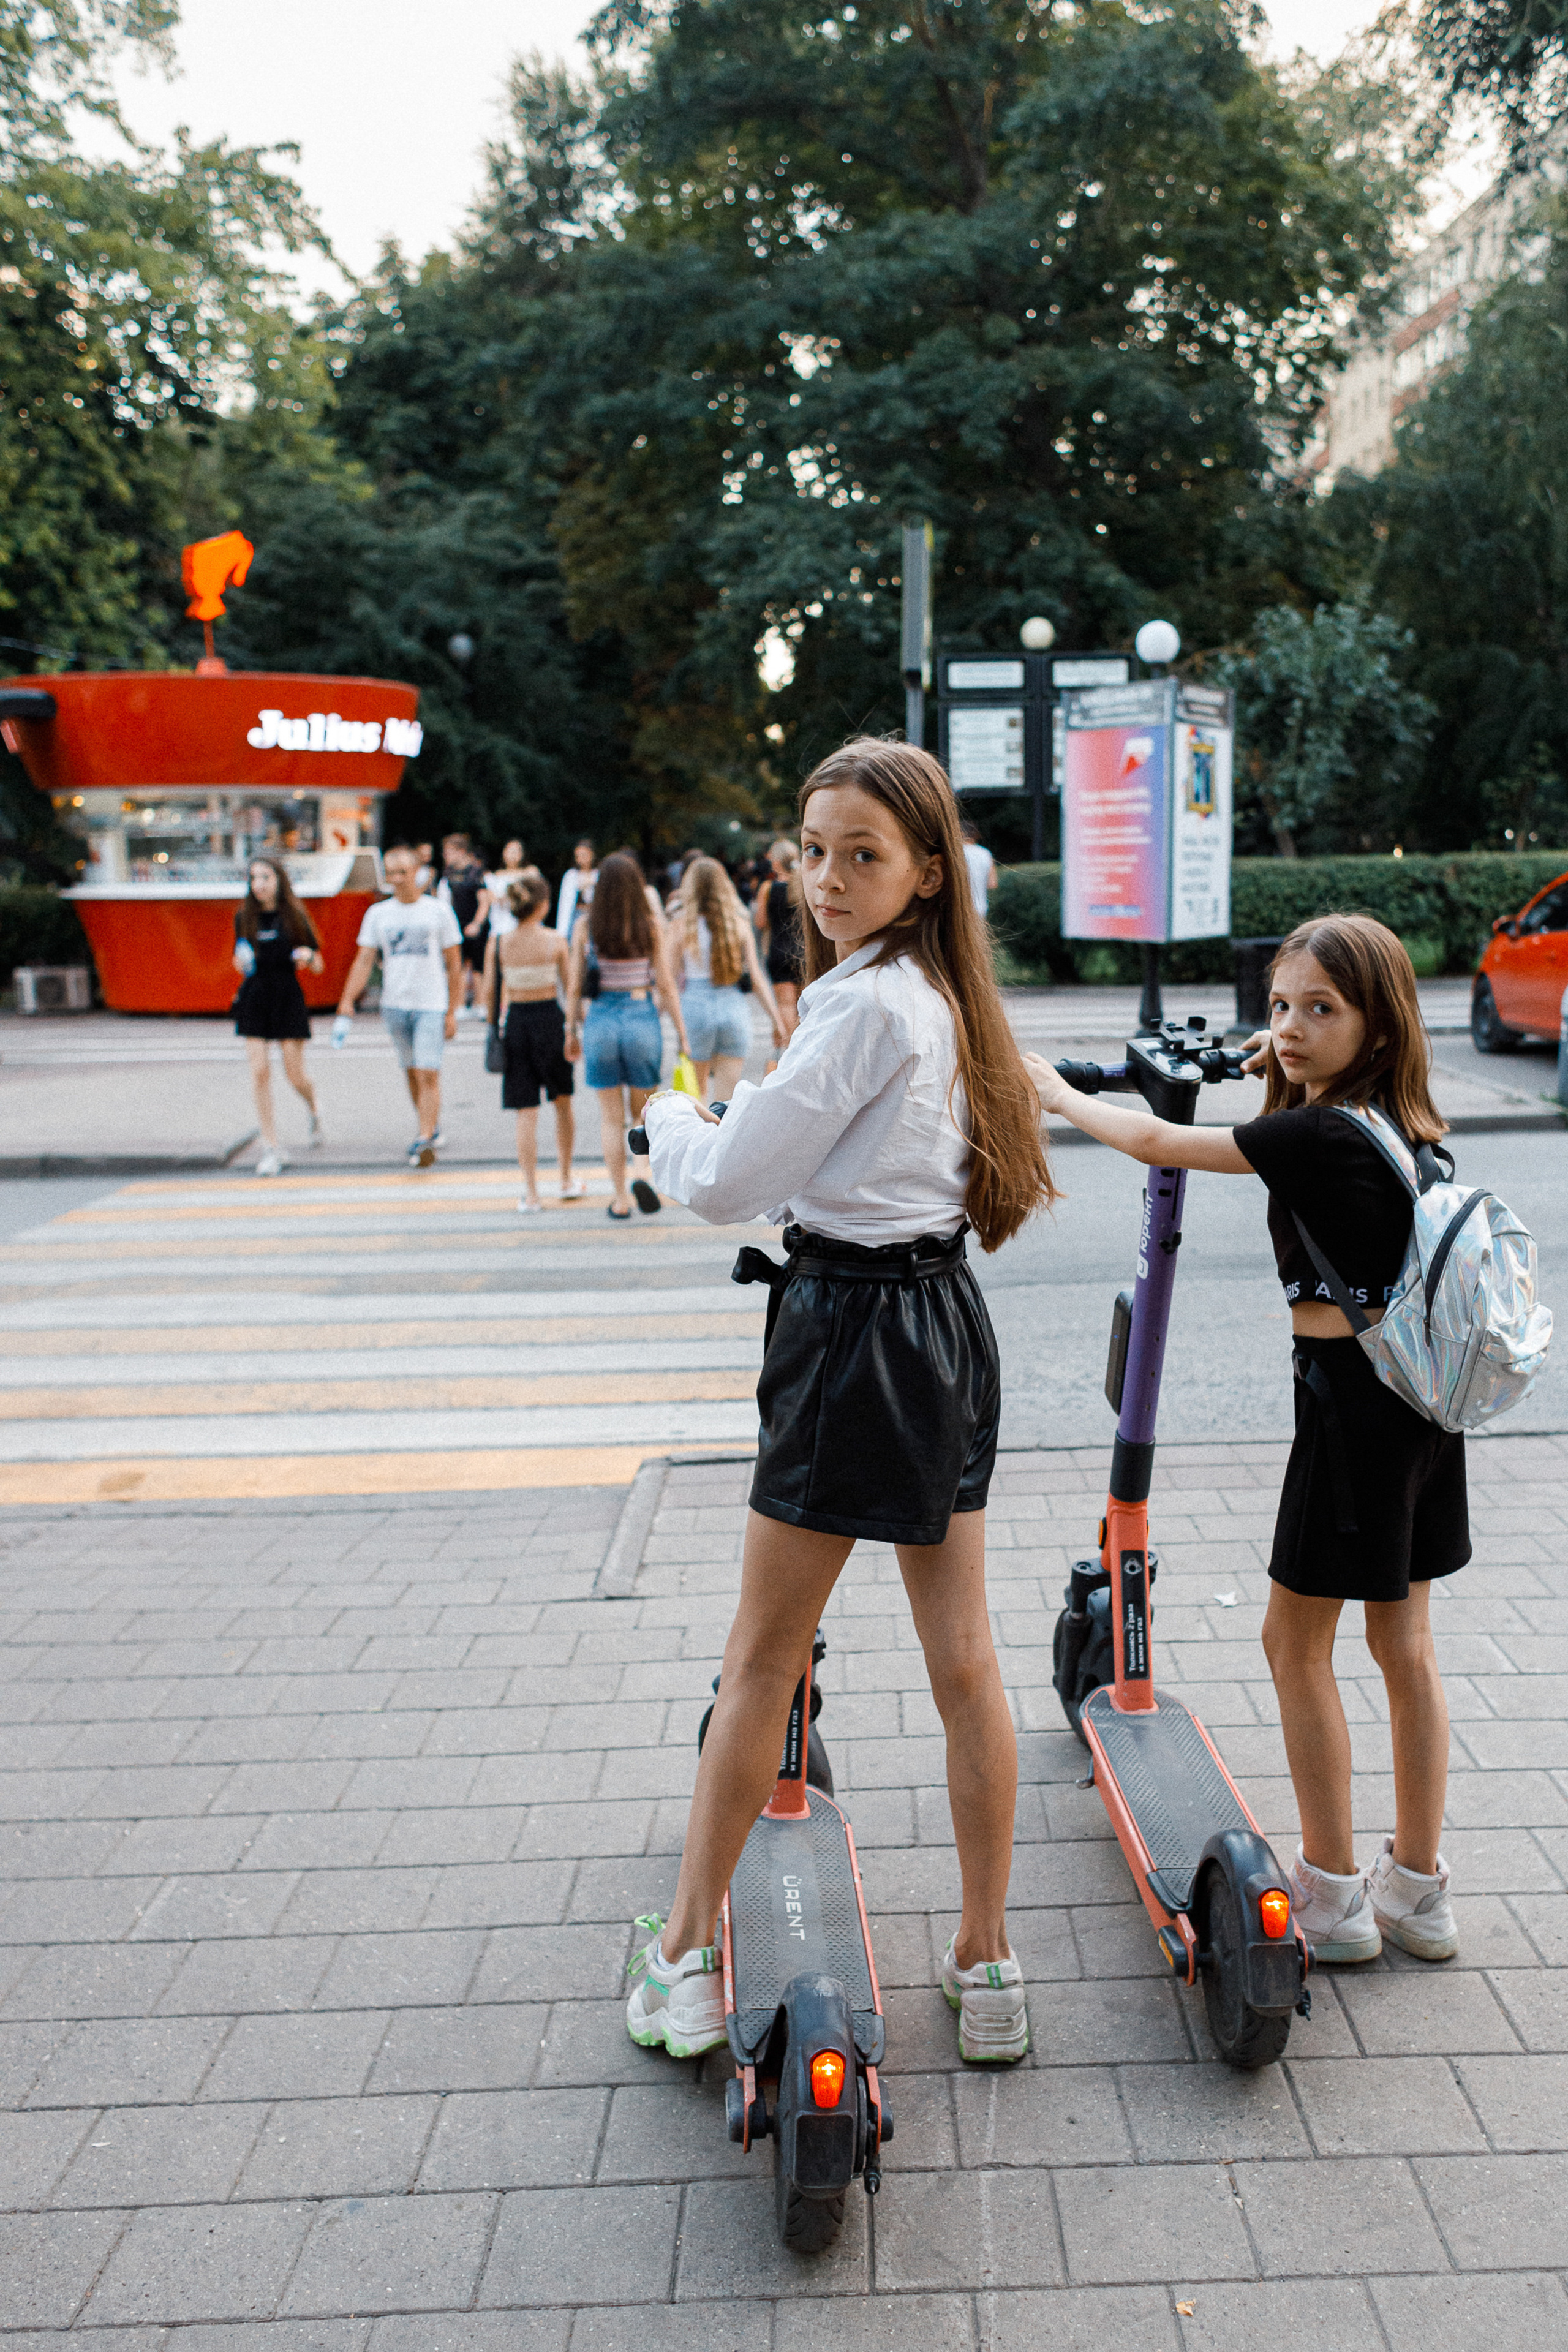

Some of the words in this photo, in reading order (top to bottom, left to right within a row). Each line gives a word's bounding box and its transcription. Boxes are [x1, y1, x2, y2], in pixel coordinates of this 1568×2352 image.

[247, 709, 382, 753] Julius
[1140, 1193, 1153, 1253] юрент
[1284, 1281, 1300, 1301] ARIS
[1137, 1632, 1144, 1643] на
[791, 1727, 797, 1739] на
[783, 1875, 805, 1941] ÜRENT
